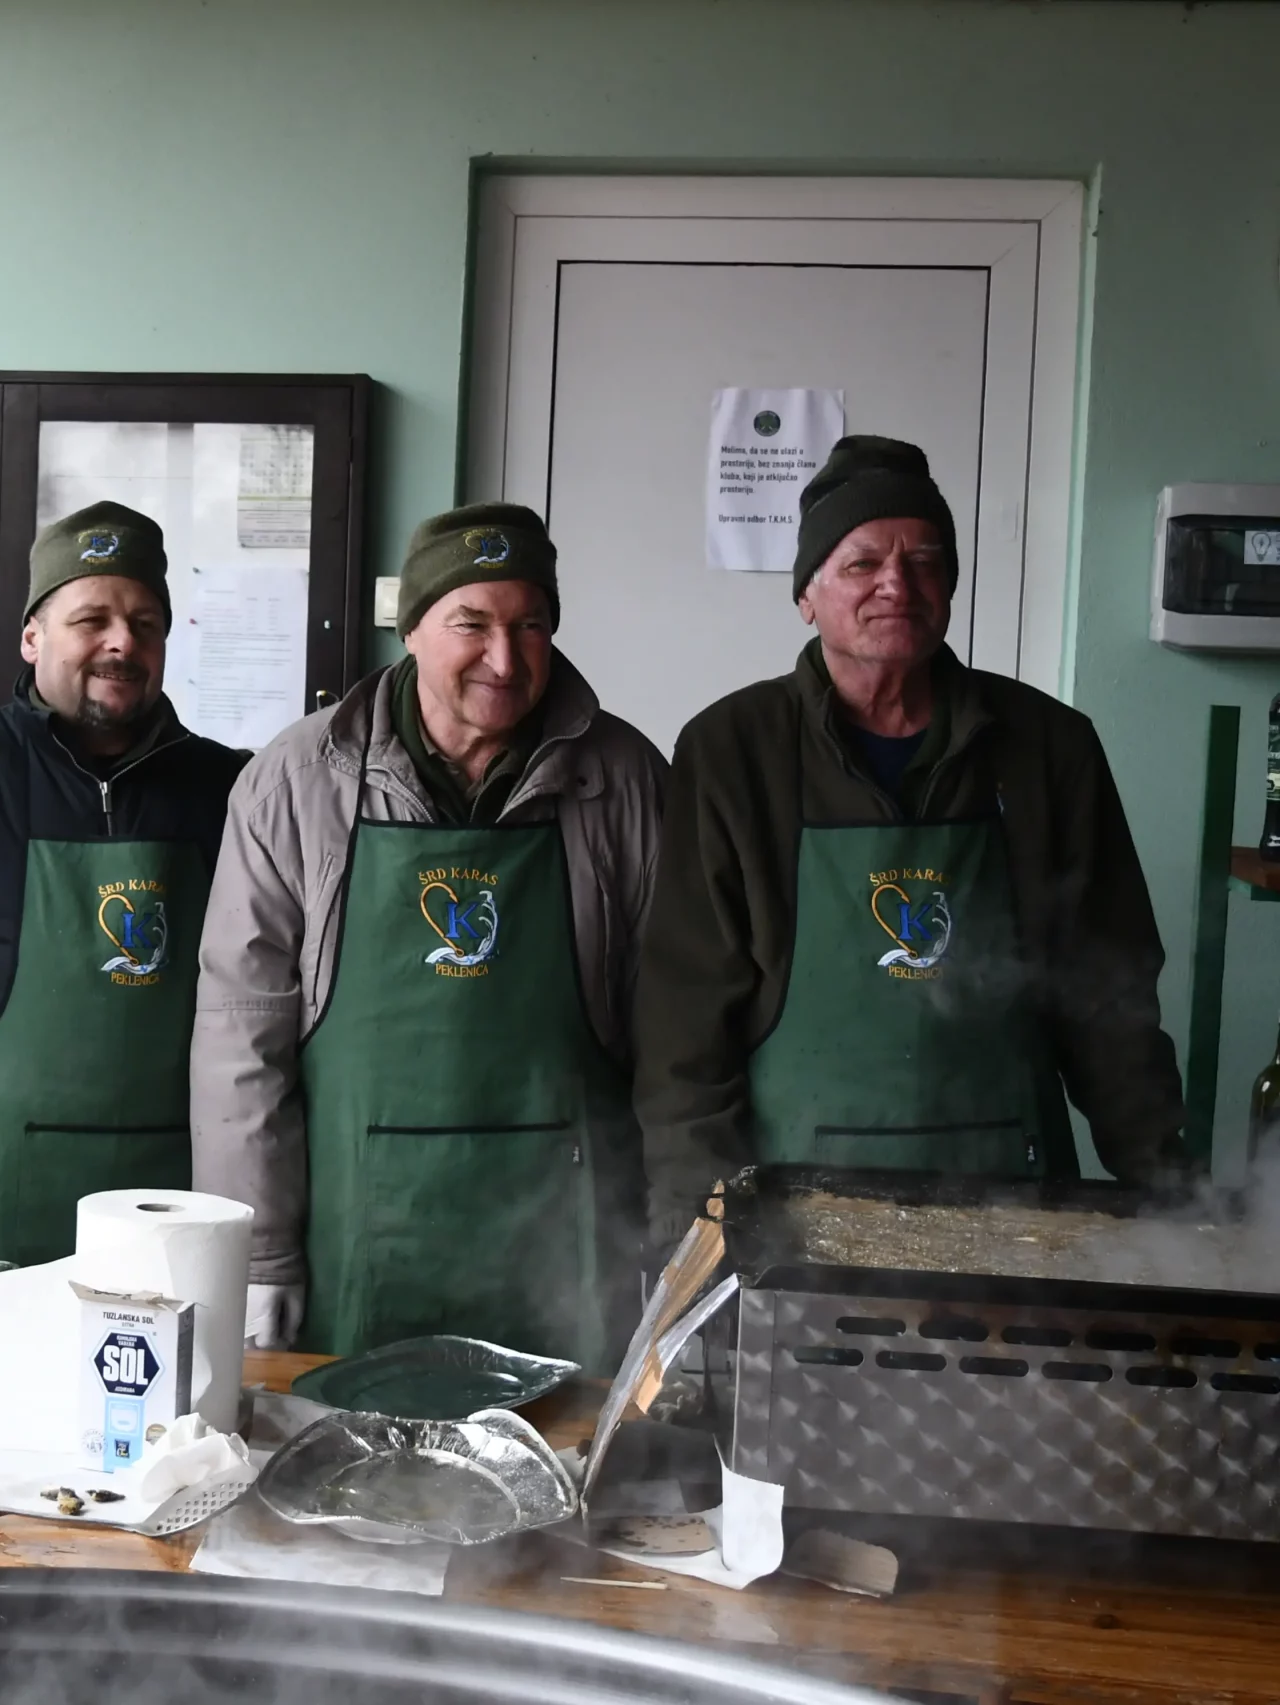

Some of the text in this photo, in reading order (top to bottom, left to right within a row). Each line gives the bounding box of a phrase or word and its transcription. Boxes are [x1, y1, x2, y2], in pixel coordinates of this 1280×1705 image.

[749, 447, 758, 455] da
[758, 460, 770, 468] bez
[772, 460, 795, 470] znanja
[743, 472, 756, 482] koji
[757, 473, 764, 483] je
[747, 515, 766, 523] odbor
[418, 867, 499, 886] ŠRD KARAS
[869, 868, 947, 887] ŠRD KARA
[98, 881, 125, 898] ŠRD
[445, 902, 480, 938] K
[897, 903, 933, 940] K
[121, 912, 154, 949] K
[435, 963, 489, 978] PEKLENICA
[103, 1311, 155, 1325] TUZLANSKA SOL
[103, 1344, 149, 1386] SOL
